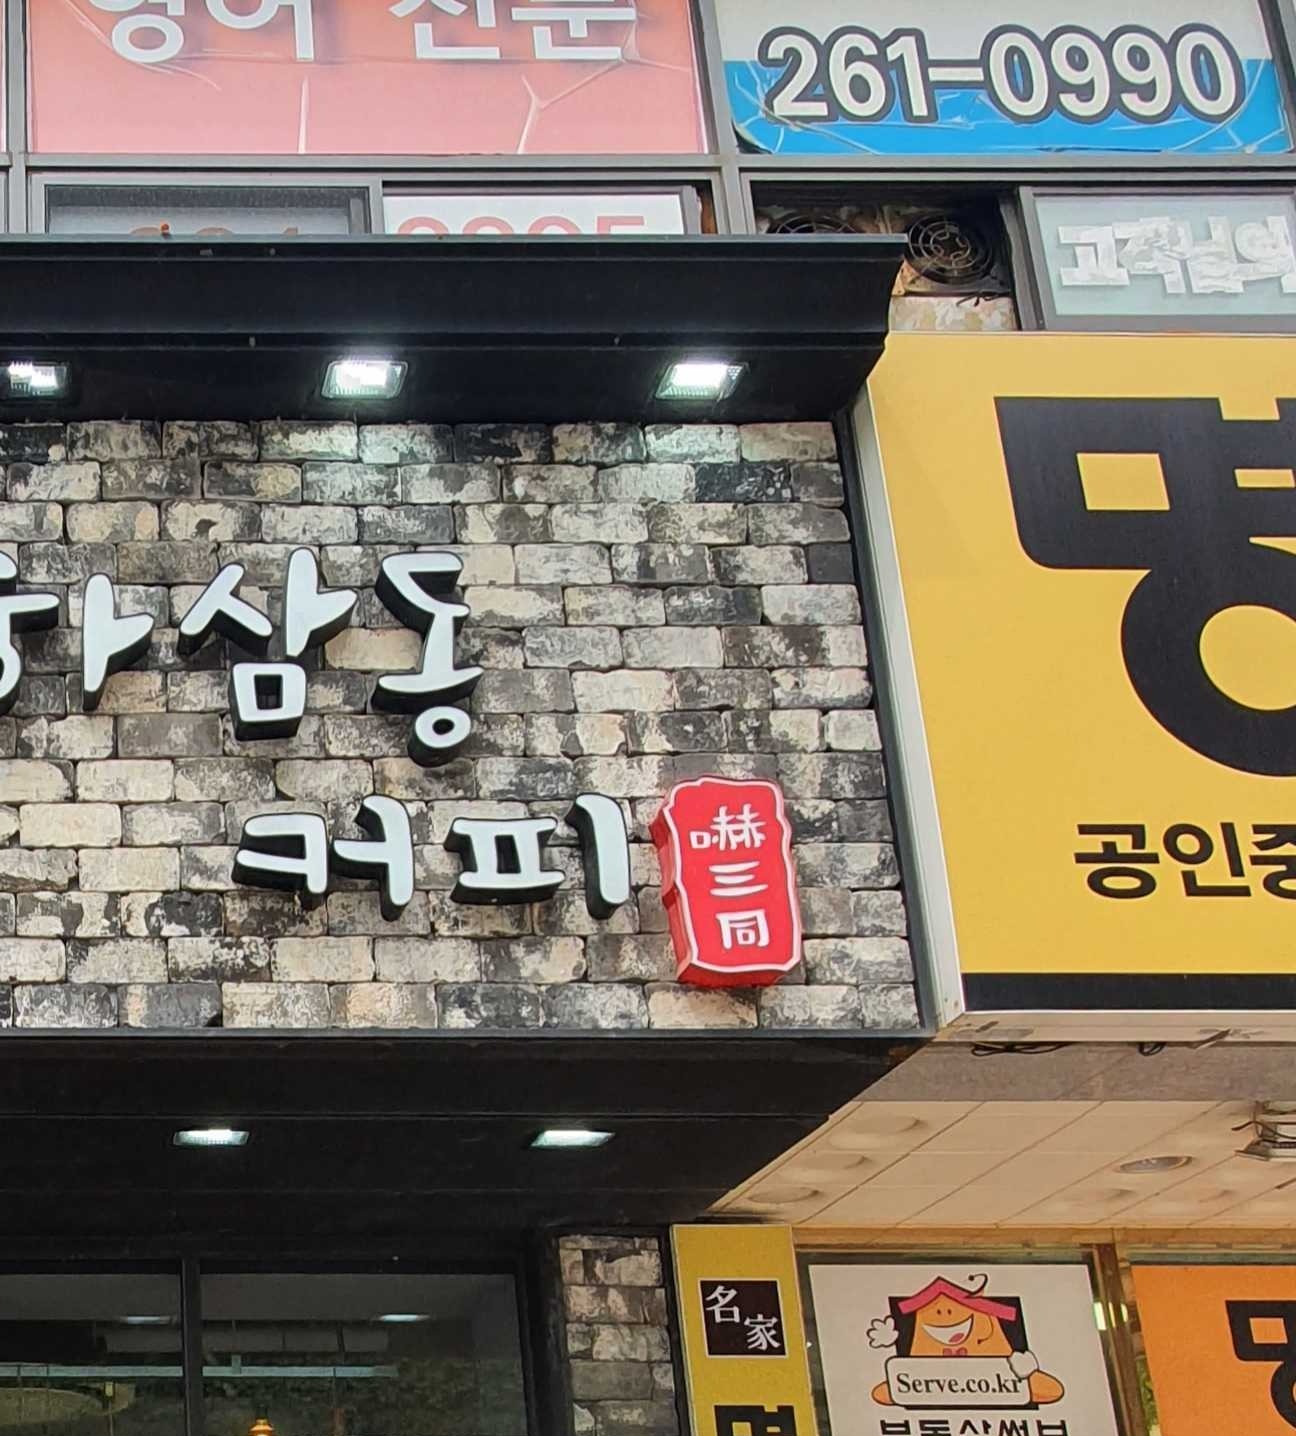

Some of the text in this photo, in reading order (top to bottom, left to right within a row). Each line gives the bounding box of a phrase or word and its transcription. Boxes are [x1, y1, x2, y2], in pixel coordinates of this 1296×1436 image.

[759, 24, 1246, 124] 261-0990
[232, 794, 631, 920] 커피
[705, 1284, 781, 1351] 名家
[896, 1372, 1023, 1396] Serve.co.kr
